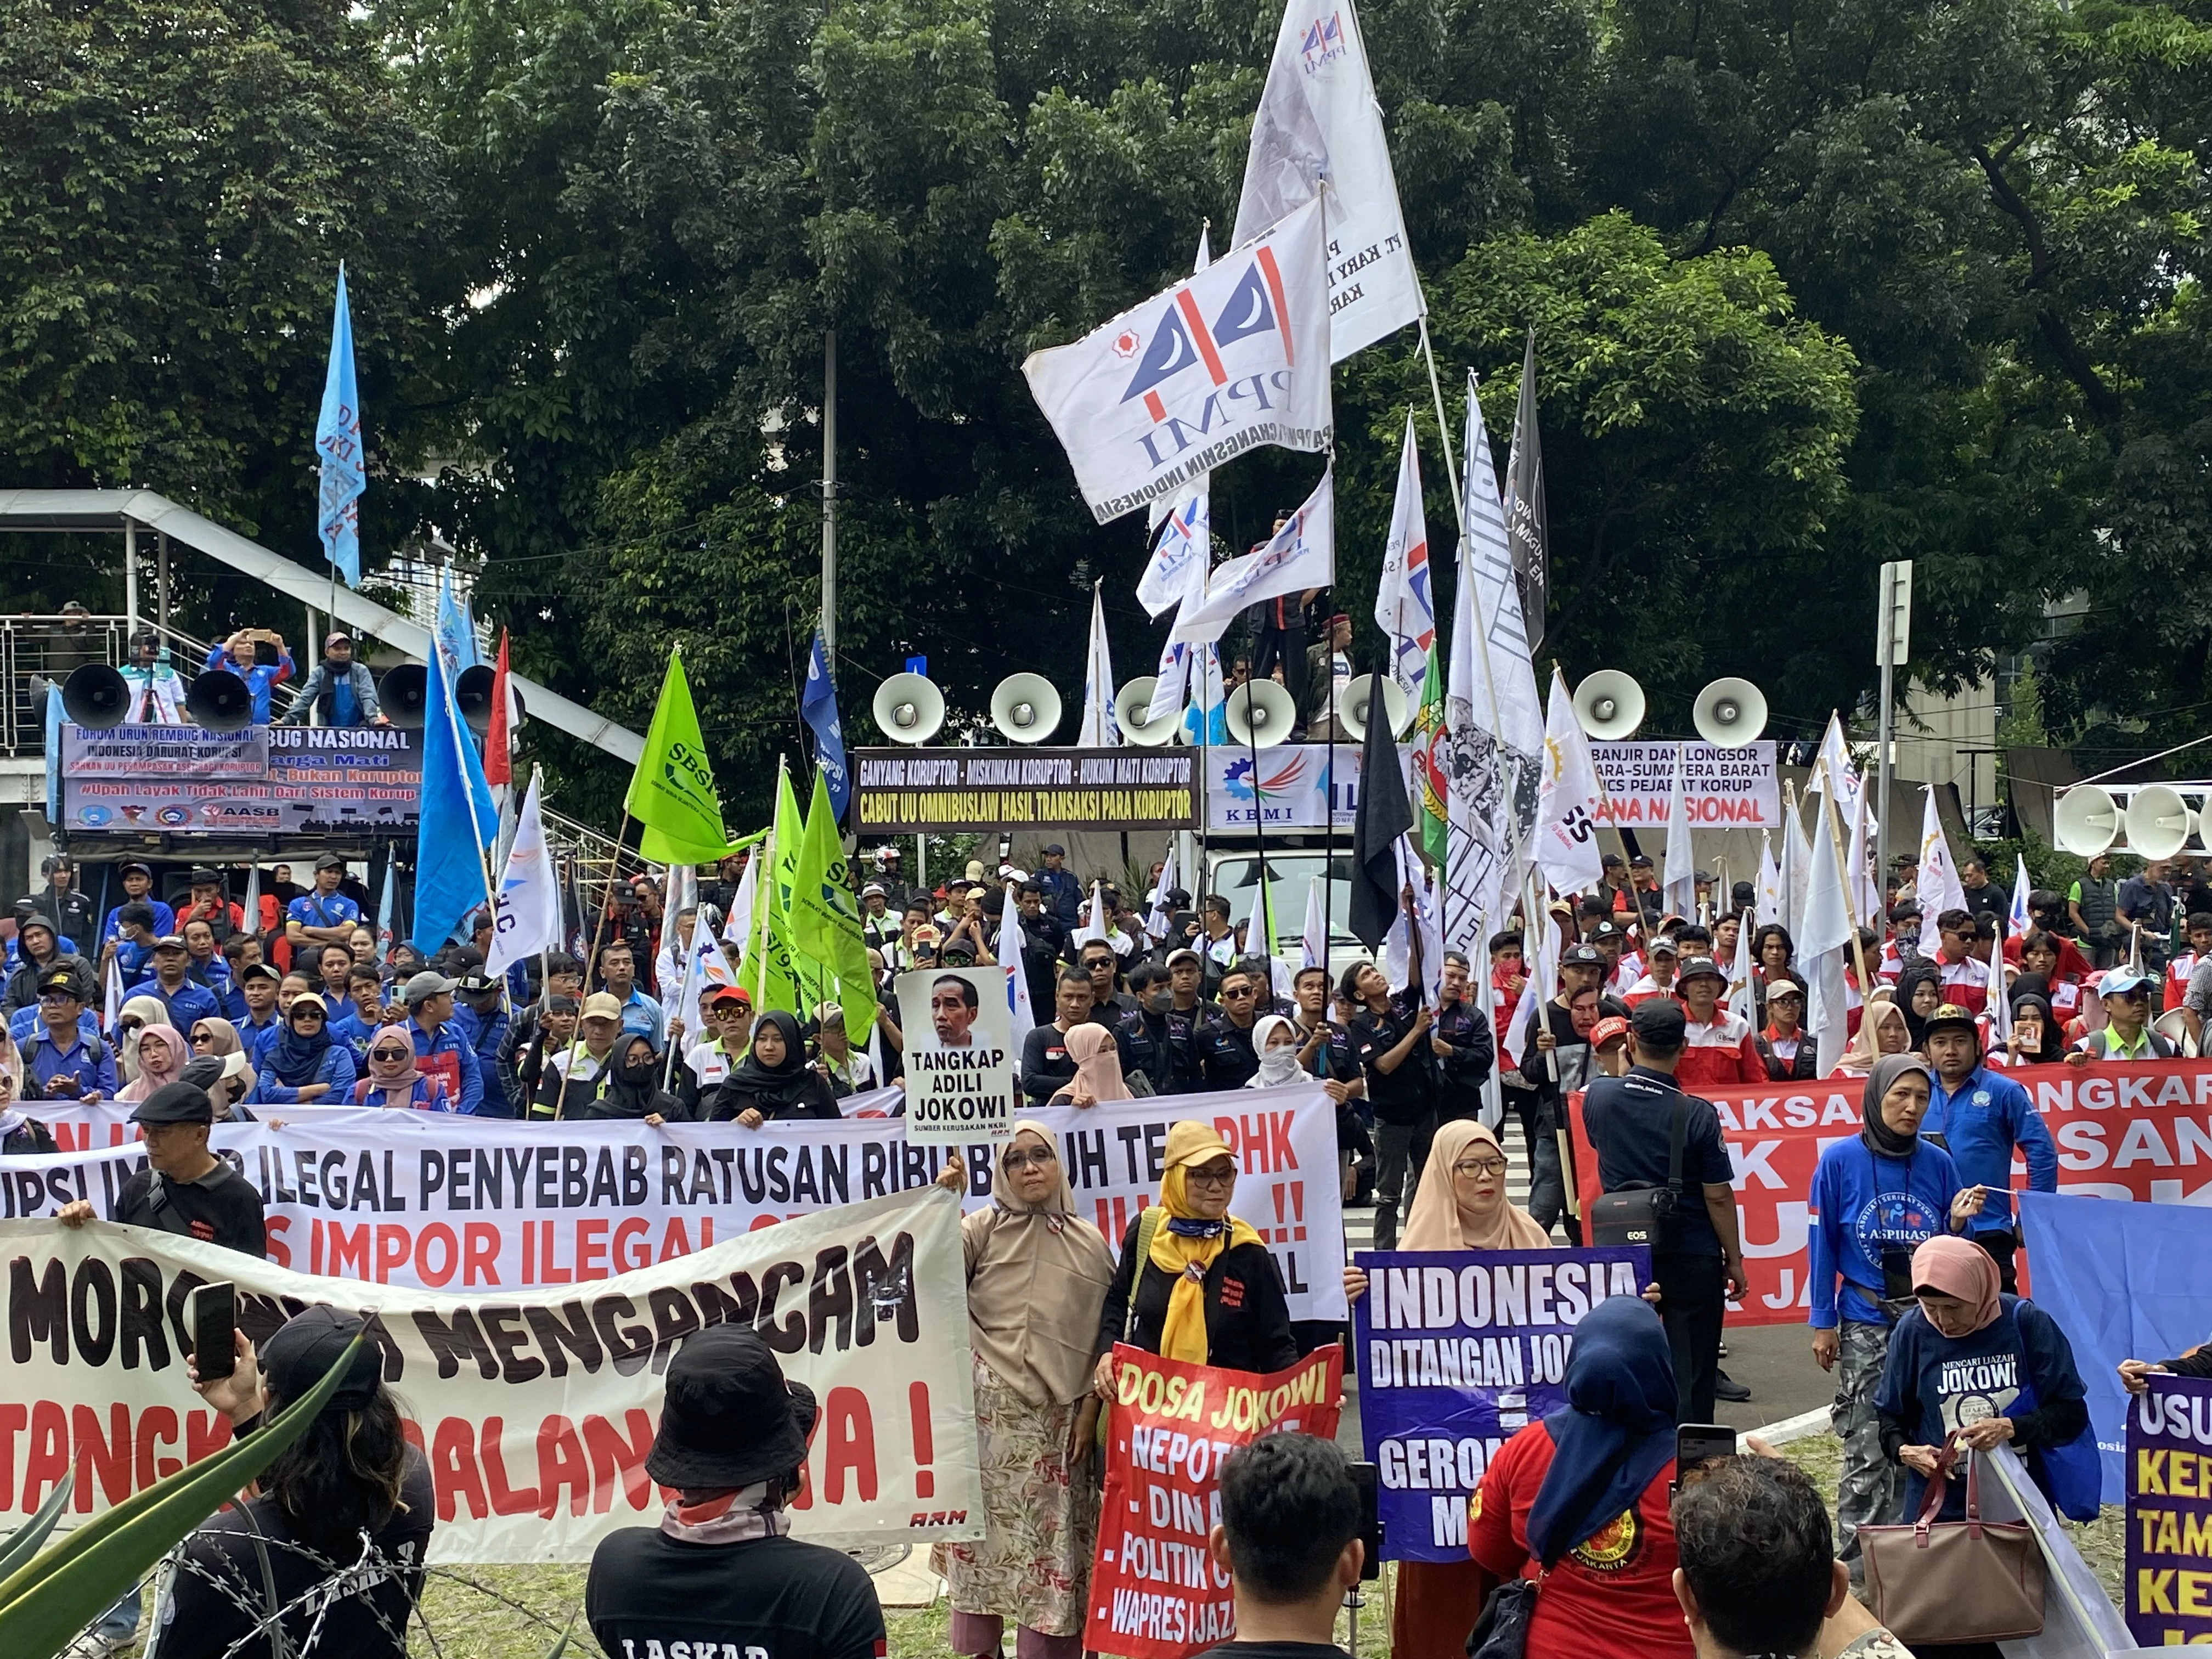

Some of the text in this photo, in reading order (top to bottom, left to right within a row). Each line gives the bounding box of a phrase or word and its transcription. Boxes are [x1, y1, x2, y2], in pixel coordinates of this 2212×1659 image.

[76, 728, 256, 742] FORUM URUN REMBUG NASIONAL
[268, 730, 411, 750] BUG NASIONAL
[87, 745, 241, 758] INDONESIA DARURAT KORUPSI
[270, 754, 390, 768] arga Mati
[1592, 748, 1643, 761] BANJIR
[1686, 748, 1758, 761] LONGSOR
[287, 769, 343, 783] Bukan
[668, 742, 714, 796] SBSI
[820, 753, 844, 782] UPSI
[860, 759, 905, 786] GANYANG
[906, 759, 958, 786] KORUPTOR
[966, 759, 1020, 786] MISKINKAN
[1020, 758, 1072, 785] KORUPTOR
[1080, 758, 1115, 785] HUKUM
[1116, 758, 1140, 784] MATI
[1141, 757, 1192, 784] KORUPTOR
[1596, 764, 1770, 777] ARA-SUMAERA BARAT
[80, 782, 131, 797] #Upah
[135, 784, 180, 798] Layak
[232, 785, 272, 799] Lahir
[275, 786, 306, 799] Dari
[311, 787, 364, 800] Sistem
[368, 787, 416, 802] Korup
[1630, 779, 1695, 792] PEJAT
[1701, 779, 1753, 792] KORUP
[223, 808, 280, 817] AASB
[860, 789, 1192, 823] CABUT UU OMNIBUSLAW HASIL TRANSAKSI PARA KORUPTOR
[1226, 808, 1293, 821] KBMI
[1589, 797, 1643, 822] ANA
[911, 1049, 1005, 1071] TANGKAP
[932, 1073, 982, 1093] ADILI
[914, 1095, 1006, 1121] JOKOWI
[1716, 1074, 2212, 1131] AKSA NGKAR
[942, 1123, 986, 1132] KERUSAKAN
[988, 1121, 1007, 1130] NKRI
[259, 1144, 406, 1212] ILEGAL
[419, 1144, 648, 1211] PENYEBAB
[662, 1142, 850, 1206] RATUSAN
[968, 1128, 1109, 1198] BUH
[1116, 1121, 1178, 1185] TE
[1213, 1109, 1299, 1175] PHK
[1627, 1231, 1647, 1240] EOS
[1869, 1229, 1931, 1240] ASPIRASI
[310, 1217, 501, 1289] IMPOR
[1369, 1261, 1638, 1330] INDONESIA
[411, 1231, 920, 1385] MENGANCAM
[1370, 1336, 1525, 1389] DITANGAN
[1942, 1353, 2015, 1371] MENCARI IJAZAH
[1936, 1362, 2018, 1395] JOKOWI
[1117, 1360, 1327, 1435] DOSA JOKOWI
[909, 1510, 967, 1528] ARM
[1120, 1532, 1208, 1591] POLITIK
[1576, 1553, 1628, 1571] JAKARTA
[1111, 1587, 1187, 1642] WAPRES
[1189, 1601, 1238, 1645] IJAZA
